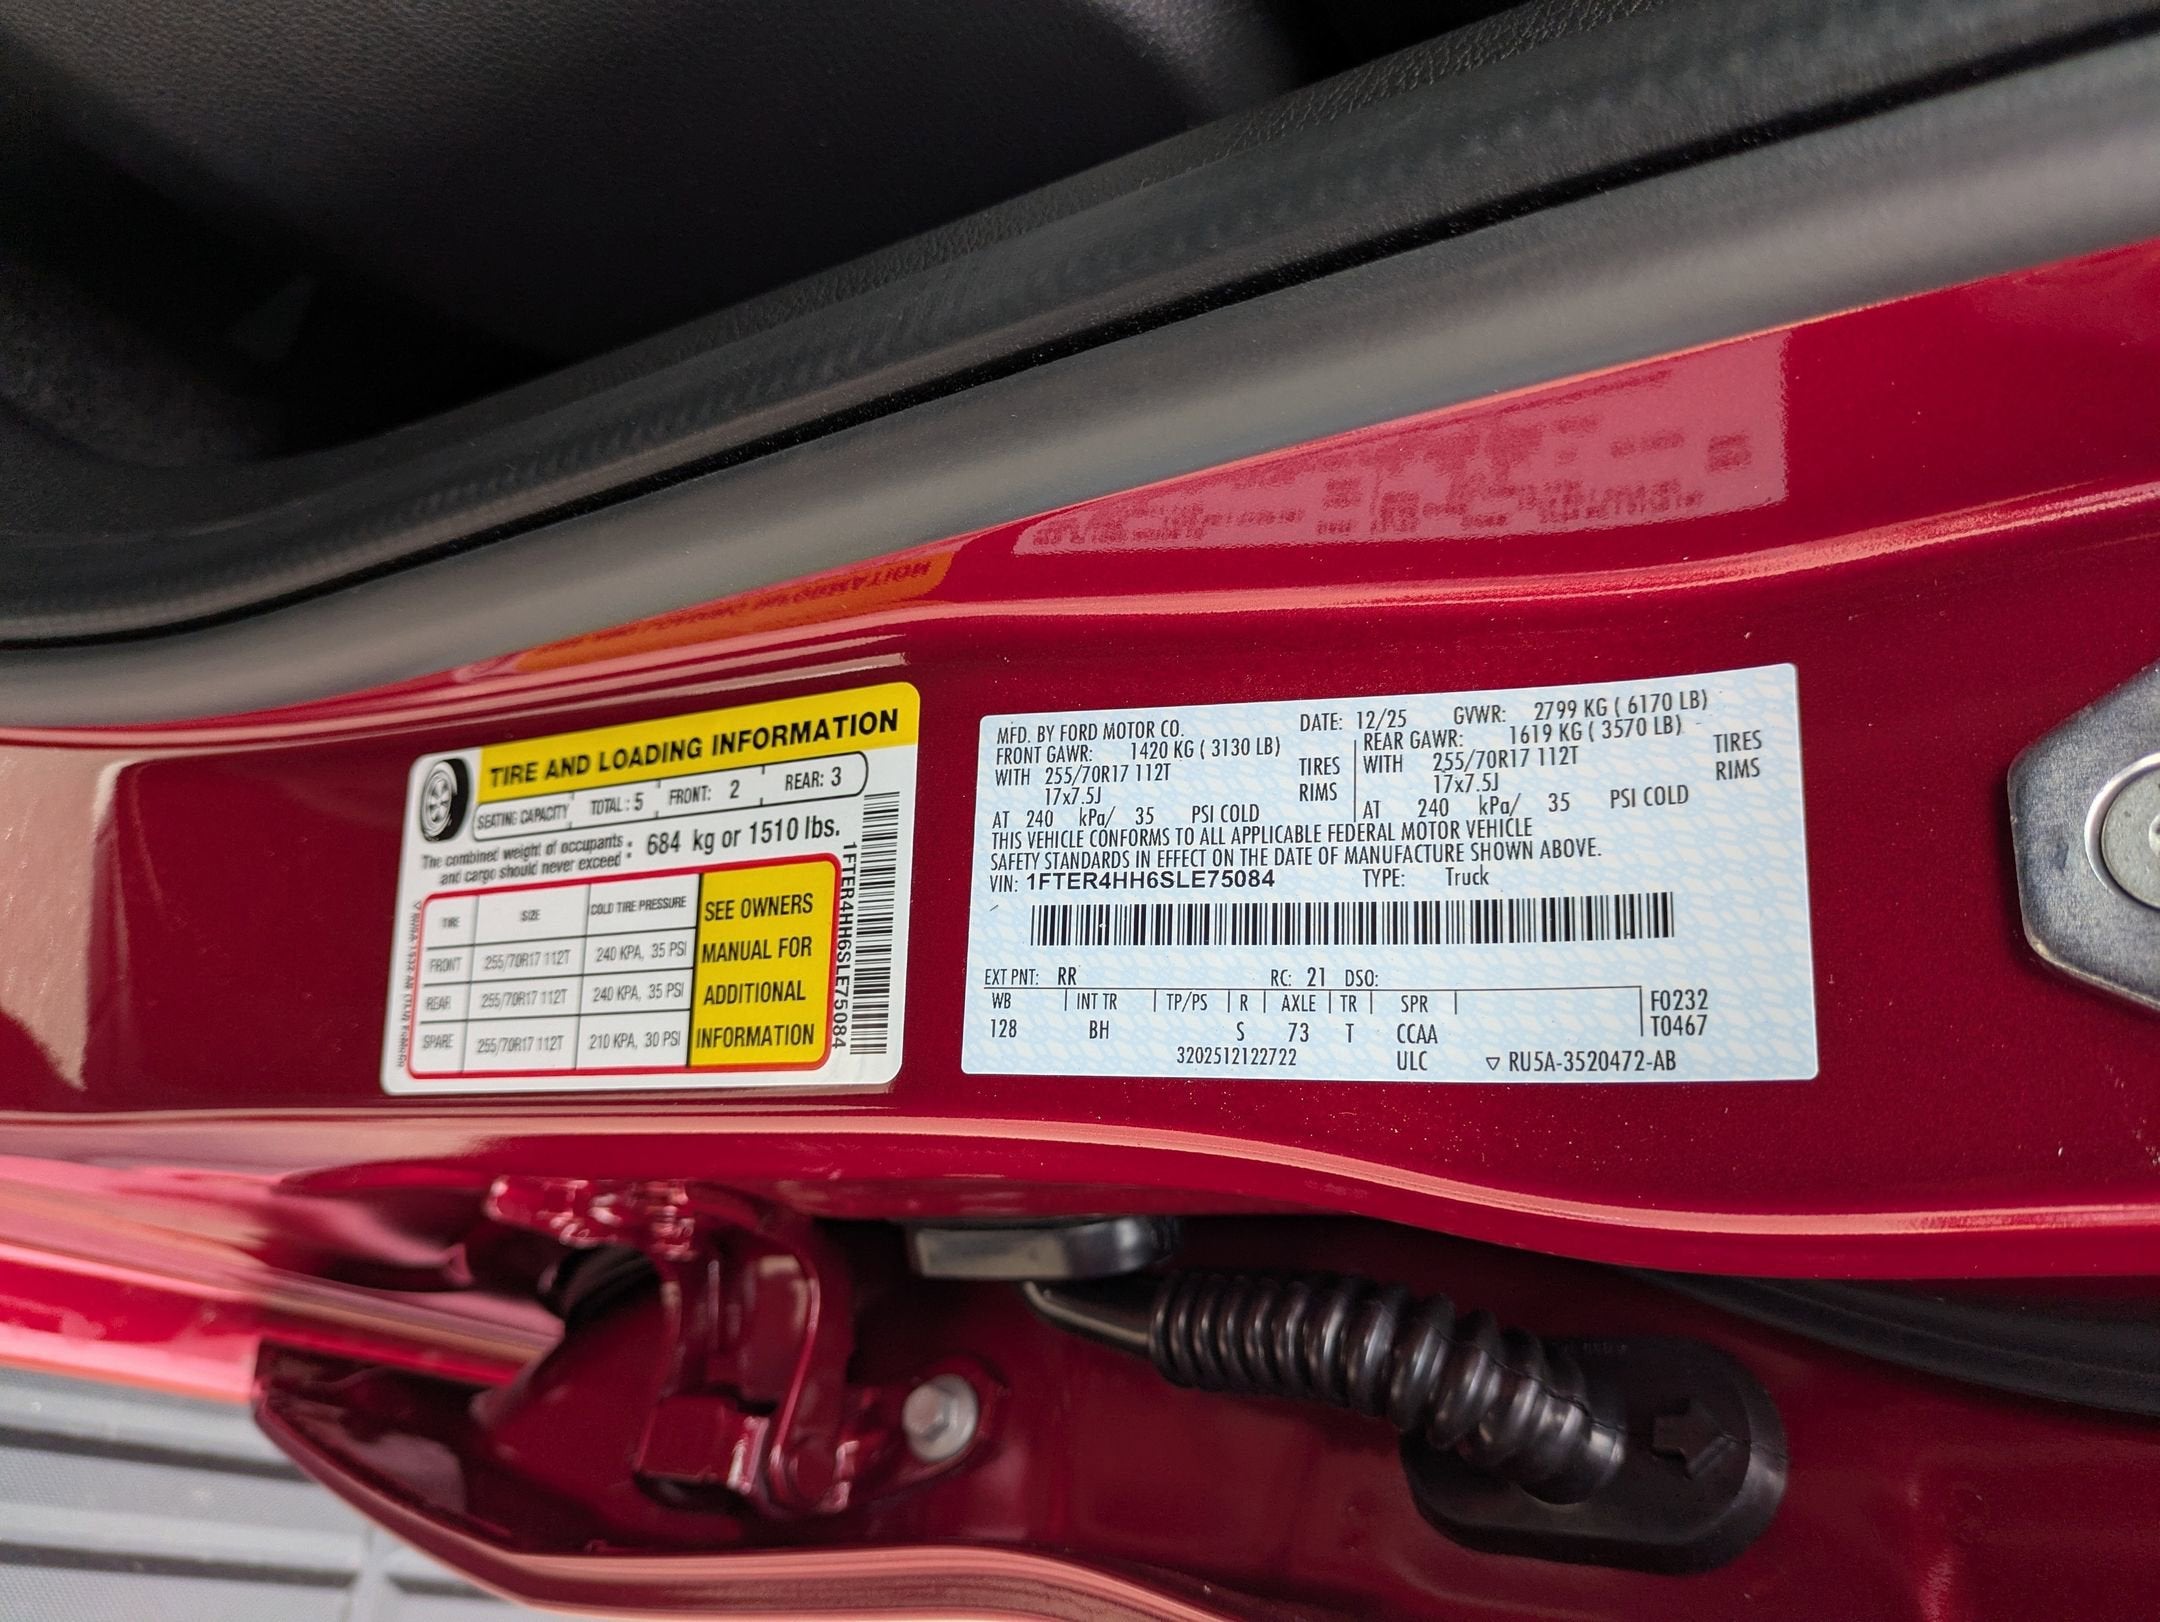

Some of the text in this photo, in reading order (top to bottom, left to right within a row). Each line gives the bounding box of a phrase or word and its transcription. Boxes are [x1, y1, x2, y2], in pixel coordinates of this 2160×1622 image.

[1453, 689, 1708, 724] GVWR: 2799 KG 6170 LB)
[1300, 708, 1407, 731] DATE: 12/25
[996, 719, 1184, 744] MFD. BY FORD MOTOR CO.
[1363, 714, 1682, 751] REAR GAWR: 1619 KG 3570 LB)
[1713, 730, 1763, 753] TIRES
[490, 708, 898, 787] TIRE AND LOADING INFORMATION
[996, 736, 1281, 765] FRONT GAWR: 1420 KG 3130 LB)
[1299, 756, 1340, 776] TIRES
[1363, 745, 1579, 774] WITH 255/70R17 112T
[1716, 757, 1760, 781] RIMS
[785, 767, 841, 791] REAR: 3
[995, 763, 1171, 786] WITH 255/70R17 112T
[1434, 772, 1499, 794] 17x7.5J
[634, 792, 644, 811] 5
[669, 780, 740, 805] FRONT: 2
[1045, 786, 1102, 805] 17x7.5J
[1300, 782, 1338, 802] RIMS
[1362, 784, 1689, 820] AT 240 kPa/ 35 PSI COLD
[477, 804, 570, 830] SEATING CAPACITY
[992, 803, 1260, 829] AT 240 kPa/ 35 PSI COLD
[647, 816, 840, 855] 684 kg or 1510 lbs.
[992, 817, 1533, 850] THIS VEHICLE CONFORMS TO ALL APPLICABLE FEDERAL MOTOR VEHICLE
[422, 855, 441, 869] The
[446, 851, 497, 867] combined
[503, 846, 541, 862] weight
[546, 841, 557, 856] of
[991, 838, 1602, 871] SAFETY STANDARDS IN EFFECT ON THE DATE OF MANUFACTURE SHOWN ABOVE.
[440, 871, 461, 886] and
[464, 869, 496, 885] cargo
[500, 862, 538, 879] should
[542, 859, 574, 875] never
[990, 869, 1275, 893] VIN: 1FTER4HH6SLE75084
[1362, 865, 1490, 888] TYPE: Truck
[521, 909, 541, 922] SIZE
[591, 895, 687, 916] COLD TIRE PRESSURE
[704, 892, 814, 922] SEE OWNERS
[596, 946, 617, 962] 240
[651, 942, 666, 958] 35
[669, 940, 688, 957] PSI
[702, 935, 813, 963] MANUAL FOR
[832, 842, 858, 1049] 1FTER4HH6SLE75084
[485, 951, 541, 972] 255/70R17
[984, 966, 1077, 985] EXT PNT: RR
[1270, 967, 1325, 987] RC: 21
[1345, 969, 1379, 987] DSO:
[480, 990, 538, 1010] 255/70R17
[593, 985, 614, 1002] 240
[648, 983, 663, 999] 35
[666, 981, 684, 998] PSI
[704, 979, 806, 1005] ADDITIONAL
[992, 992, 1011, 1009] WB
[1077, 993, 1117, 1010] INT TR
[1166, 991, 1208, 1012] TP/PS
[1650, 988, 1708, 1011] F0232
[1240, 994, 1248, 1012] R
[1281, 994, 1316, 1012] AXLE
[1340, 994, 1357, 1013] TR
[1401, 995, 1428, 1013] SPR
[696, 1023, 815, 1049] INFORMATION
[990, 1019, 1017, 1038] 128
[1089, 1020, 1109, 1039] BH
[1236, 1021, 1245, 1041] S
[1288, 1022, 1309, 1042] 73
[1346, 1023, 1354, 1043] T
[1397, 1023, 1438, 1044] CCAA
[1650, 1014, 1708, 1037] T0467
[477, 1037, 535, 1056] 255/70R17
[589, 1034, 610, 1050] 210
[645, 1031, 661, 1047] 30
[663, 1030, 681, 1046] PSI
[1176, 1046, 1297, 1066] 3202512122722
[1397, 1051, 1428, 1071] ULC
[1509, 1050, 1677, 1072] RU5A-3520472-AB
